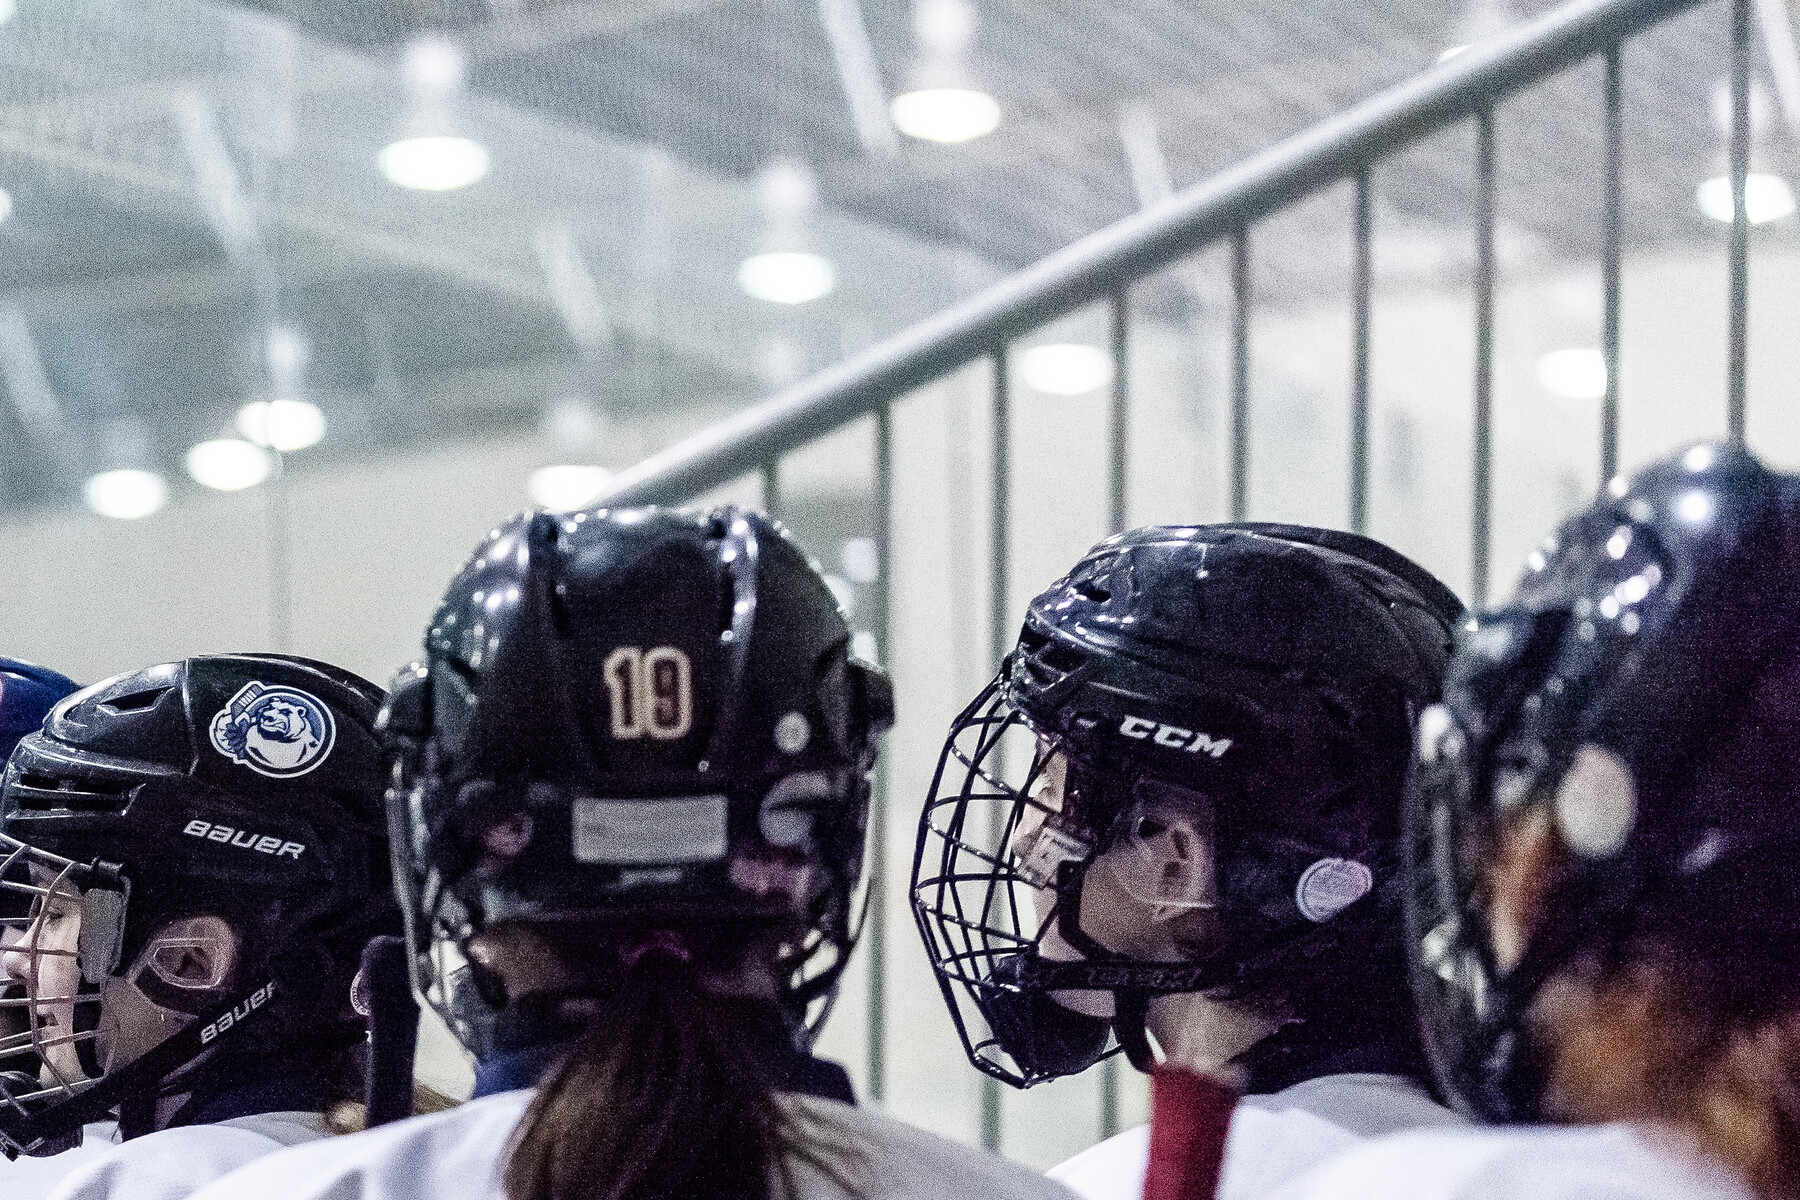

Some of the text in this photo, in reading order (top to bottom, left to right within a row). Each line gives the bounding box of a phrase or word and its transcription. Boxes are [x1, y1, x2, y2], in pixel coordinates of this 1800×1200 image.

[603, 646, 693, 740] 19
[1119, 714, 1234, 758] CCM
[183, 820, 305, 859] BAUER
[200, 979, 279, 1044] BAUER
